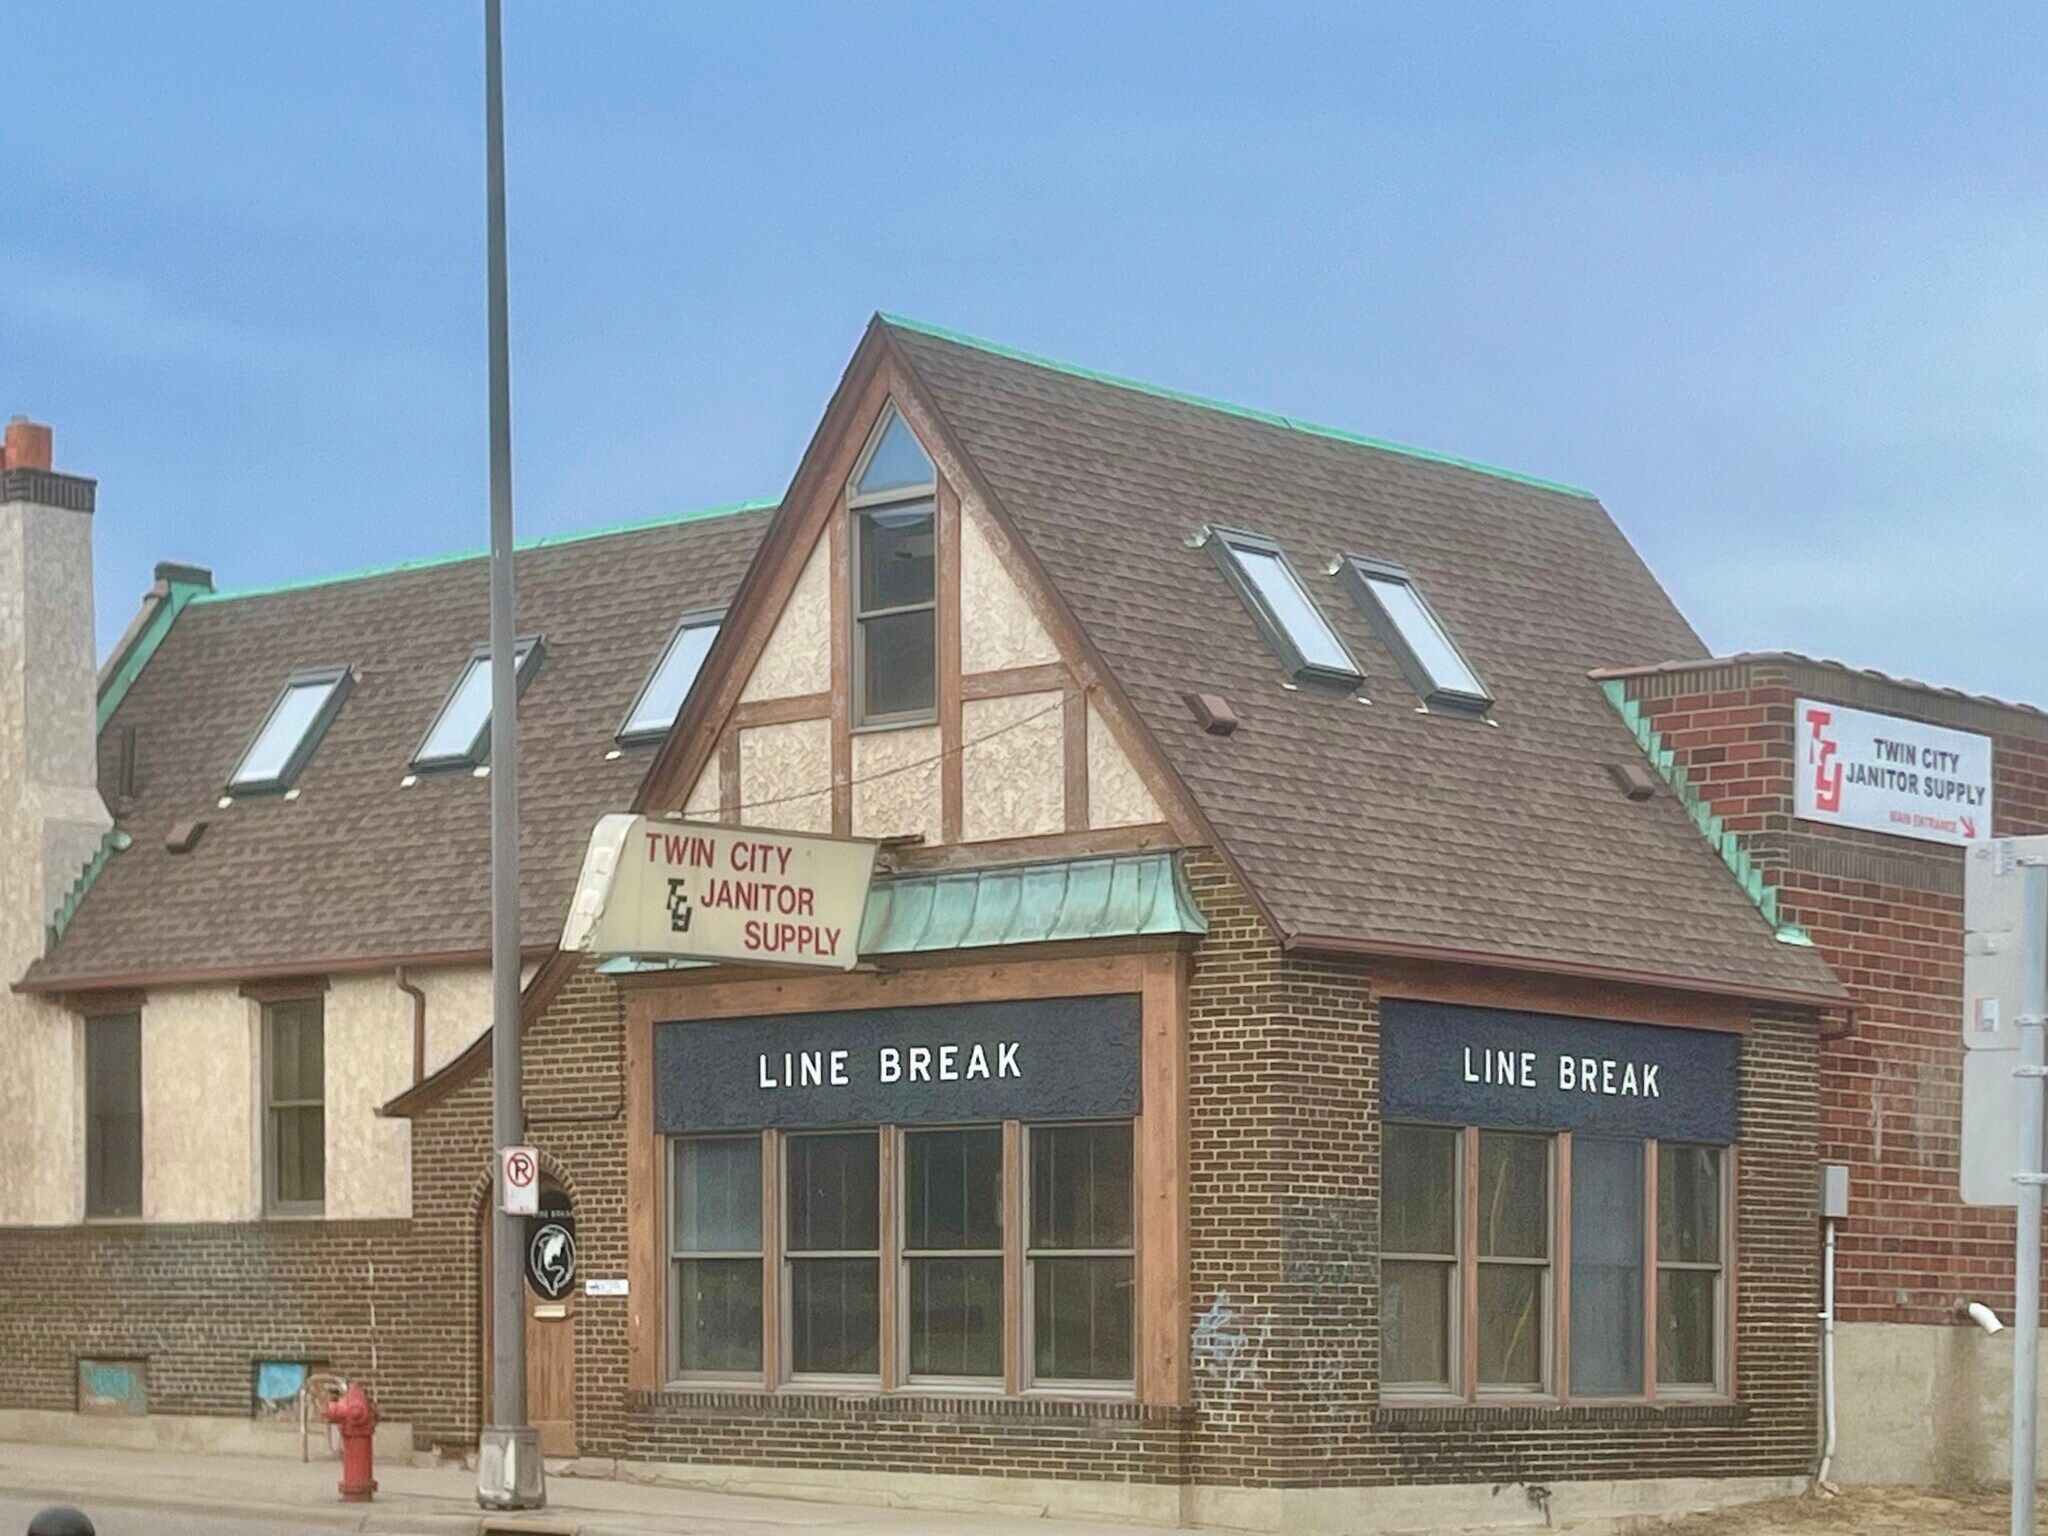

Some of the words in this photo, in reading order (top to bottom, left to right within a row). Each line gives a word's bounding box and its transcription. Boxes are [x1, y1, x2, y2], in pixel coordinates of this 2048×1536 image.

[1873, 738, 1917, 766] TWIN
[1921, 748, 1961, 774] CITY
[1845, 763, 1919, 795] JANITOR
[1924, 776, 1986, 806] SUPPLY
[645, 832, 716, 868] TWIN
[730, 841, 793, 875] CITY
[700, 878, 815, 916] JANITOR
[744, 920, 842, 956] SUPPLY
[759, 1050, 849, 1088] LINE
[880, 1042, 1022, 1083] BREAK
[1463, 1047, 1537, 1088] LINE
[1559, 1055, 1660, 1098] BREAK
